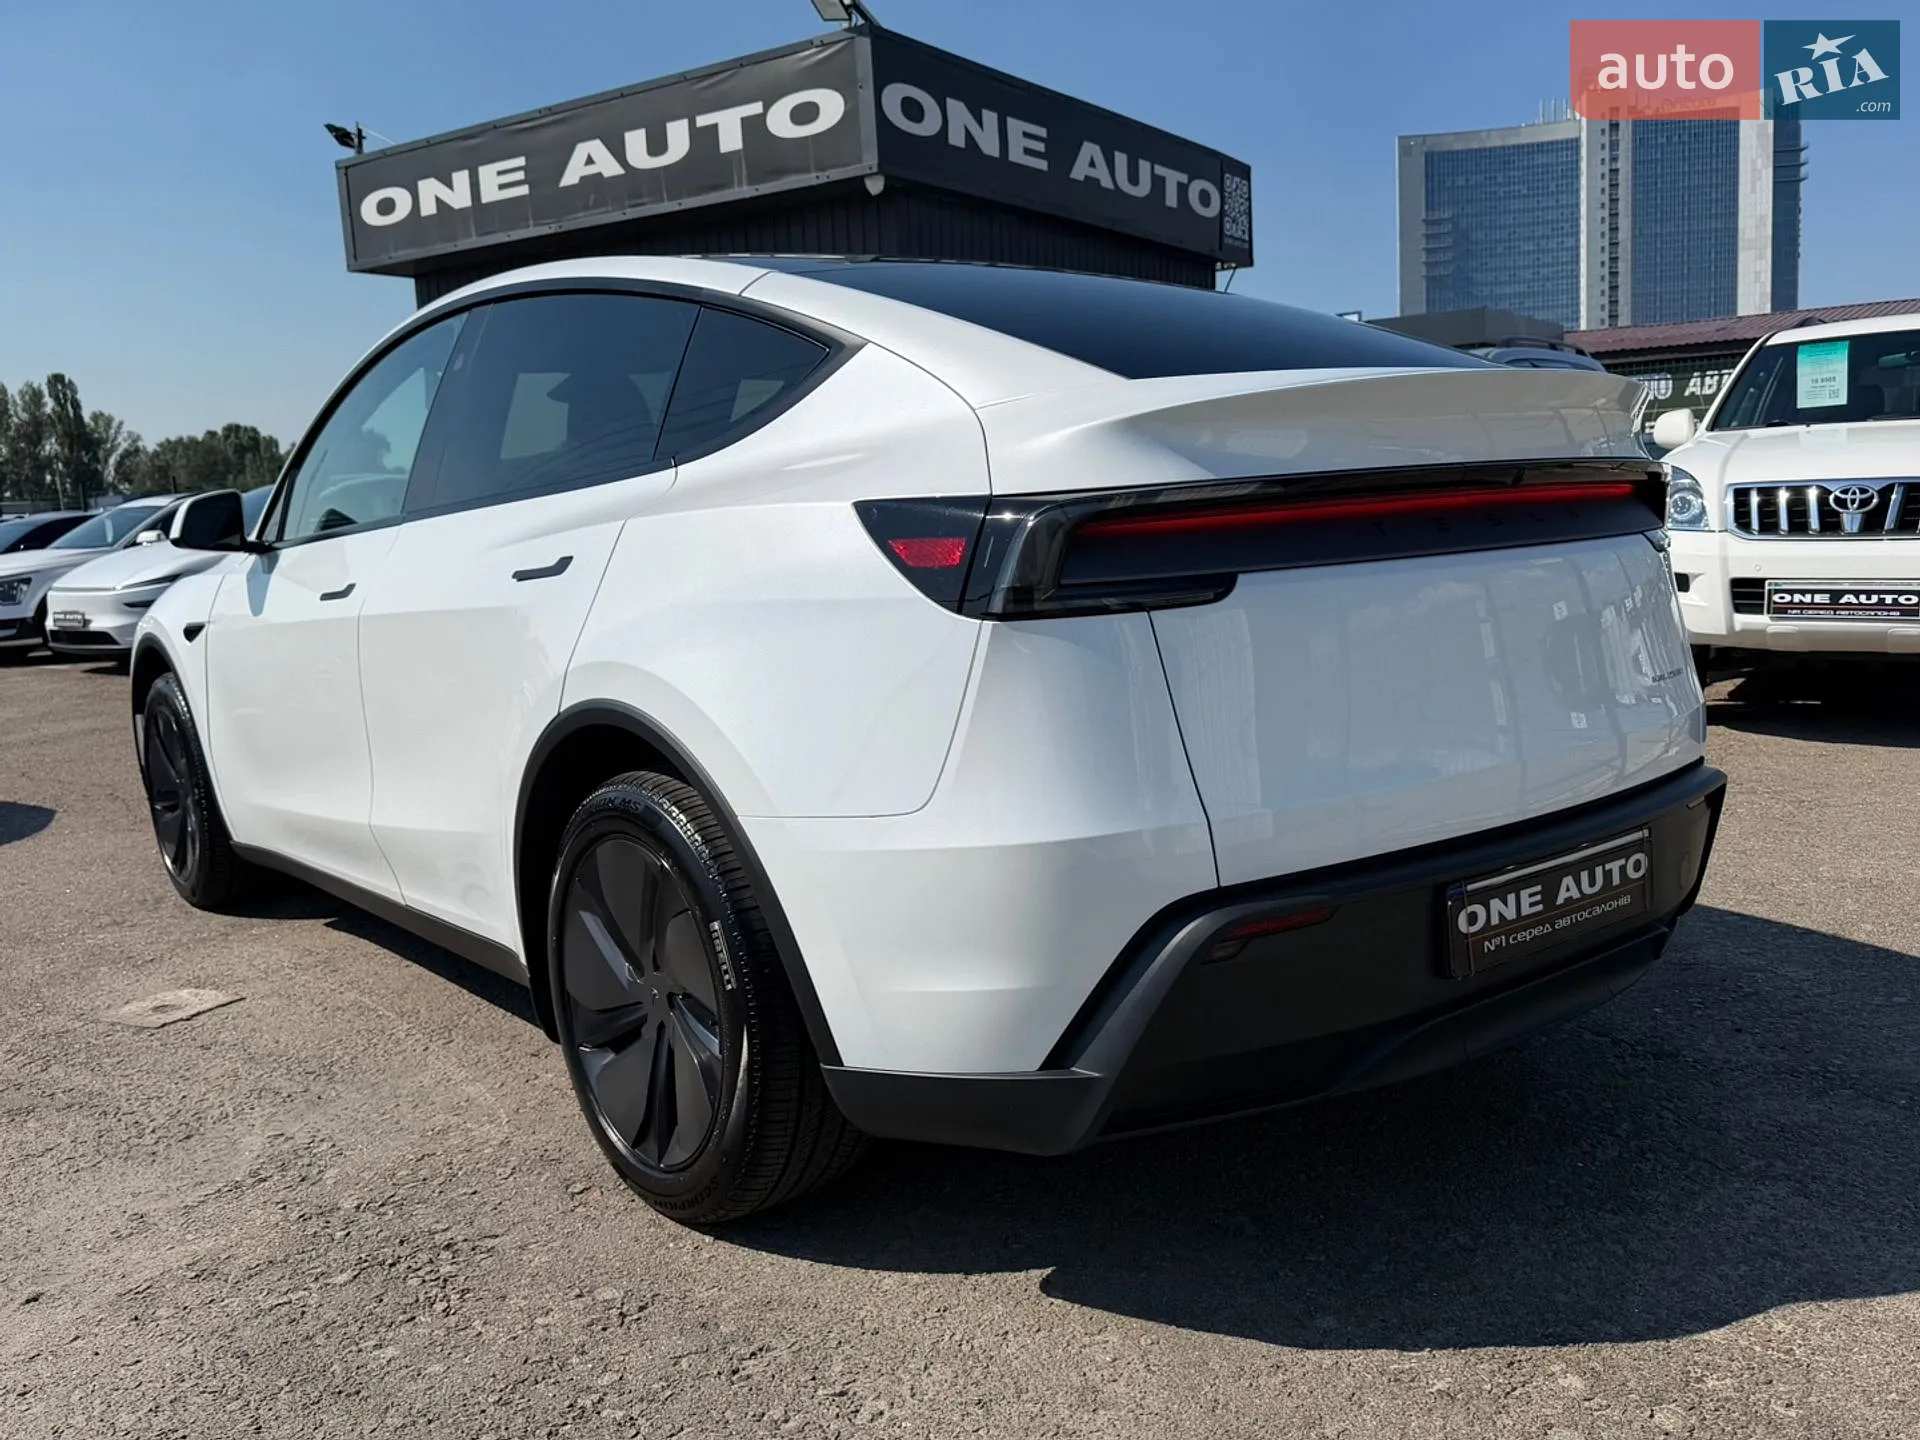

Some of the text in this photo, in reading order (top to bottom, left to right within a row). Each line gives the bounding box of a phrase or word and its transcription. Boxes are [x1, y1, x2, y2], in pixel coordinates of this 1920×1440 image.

[361, 87, 845, 227] ONE AUTO
[881, 82, 1221, 218] ONE AUTO
[1773, 593, 1919, 605] ONE AUTO
[1457, 852, 1649, 934] ONE AUTO
[1483, 894, 1632, 953] №1 серед автосалонів
